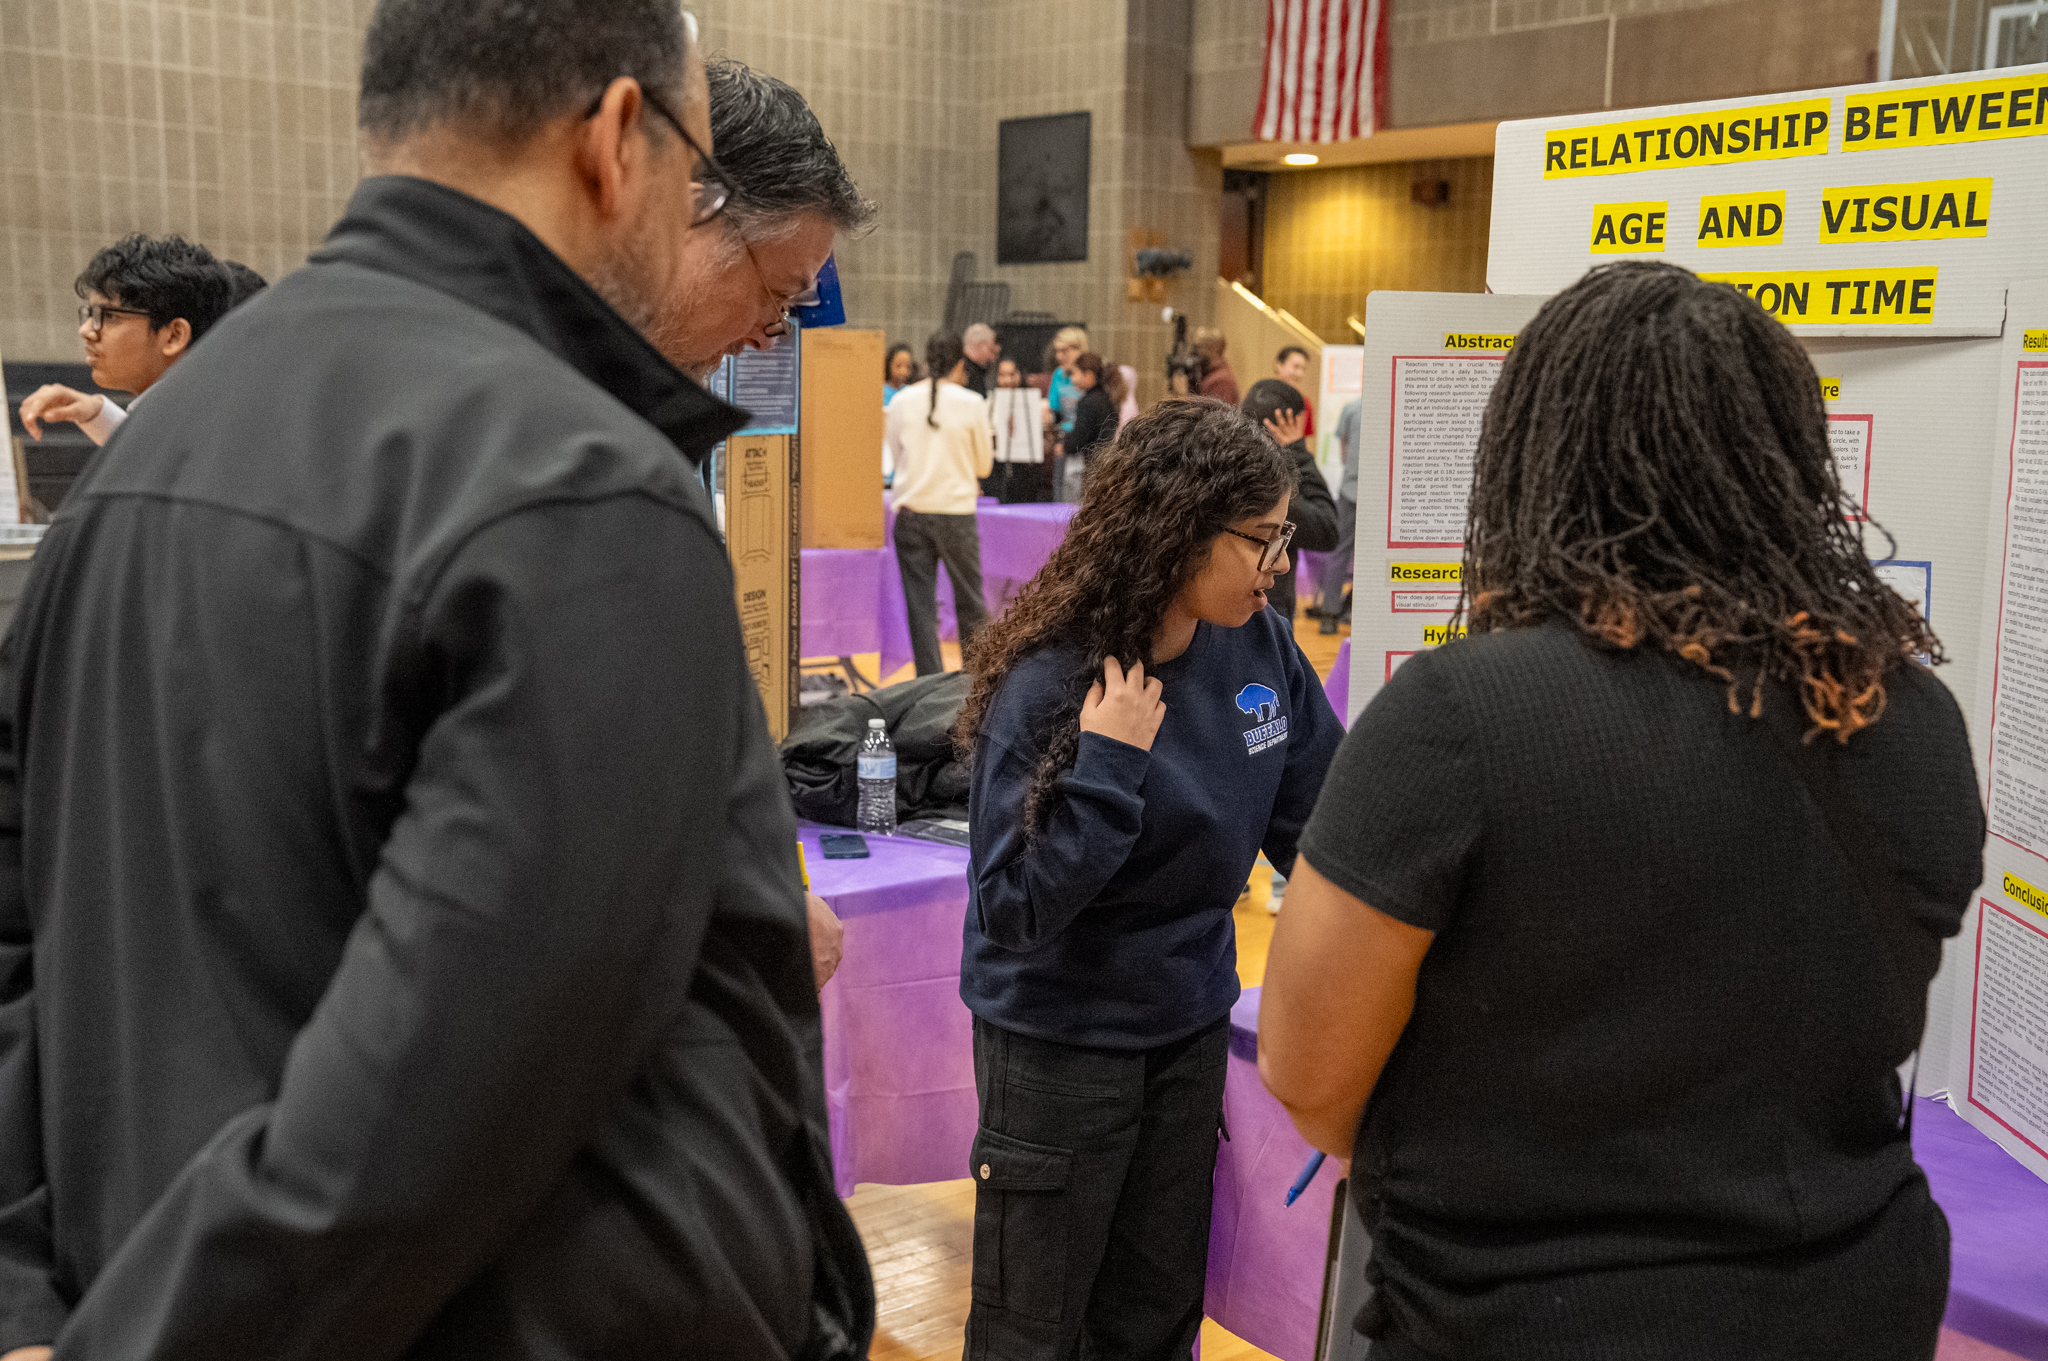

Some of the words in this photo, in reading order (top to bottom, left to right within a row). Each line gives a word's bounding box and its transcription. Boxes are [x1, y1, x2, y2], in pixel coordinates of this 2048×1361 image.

[1545, 110, 1828, 172] RELATIONSHIP
[1593, 211, 1666, 246] AGE
[1698, 202, 1783, 240] AND
[1822, 190, 1988, 234] VISUAL
[1826, 279, 1934, 315] TIME
[2023, 333, 2048, 348] Result
[1243, 716, 1288, 746] BUFFALO
[1248, 742, 1266, 755] SCIENCE
[2004, 876, 2048, 916] Conclusio
